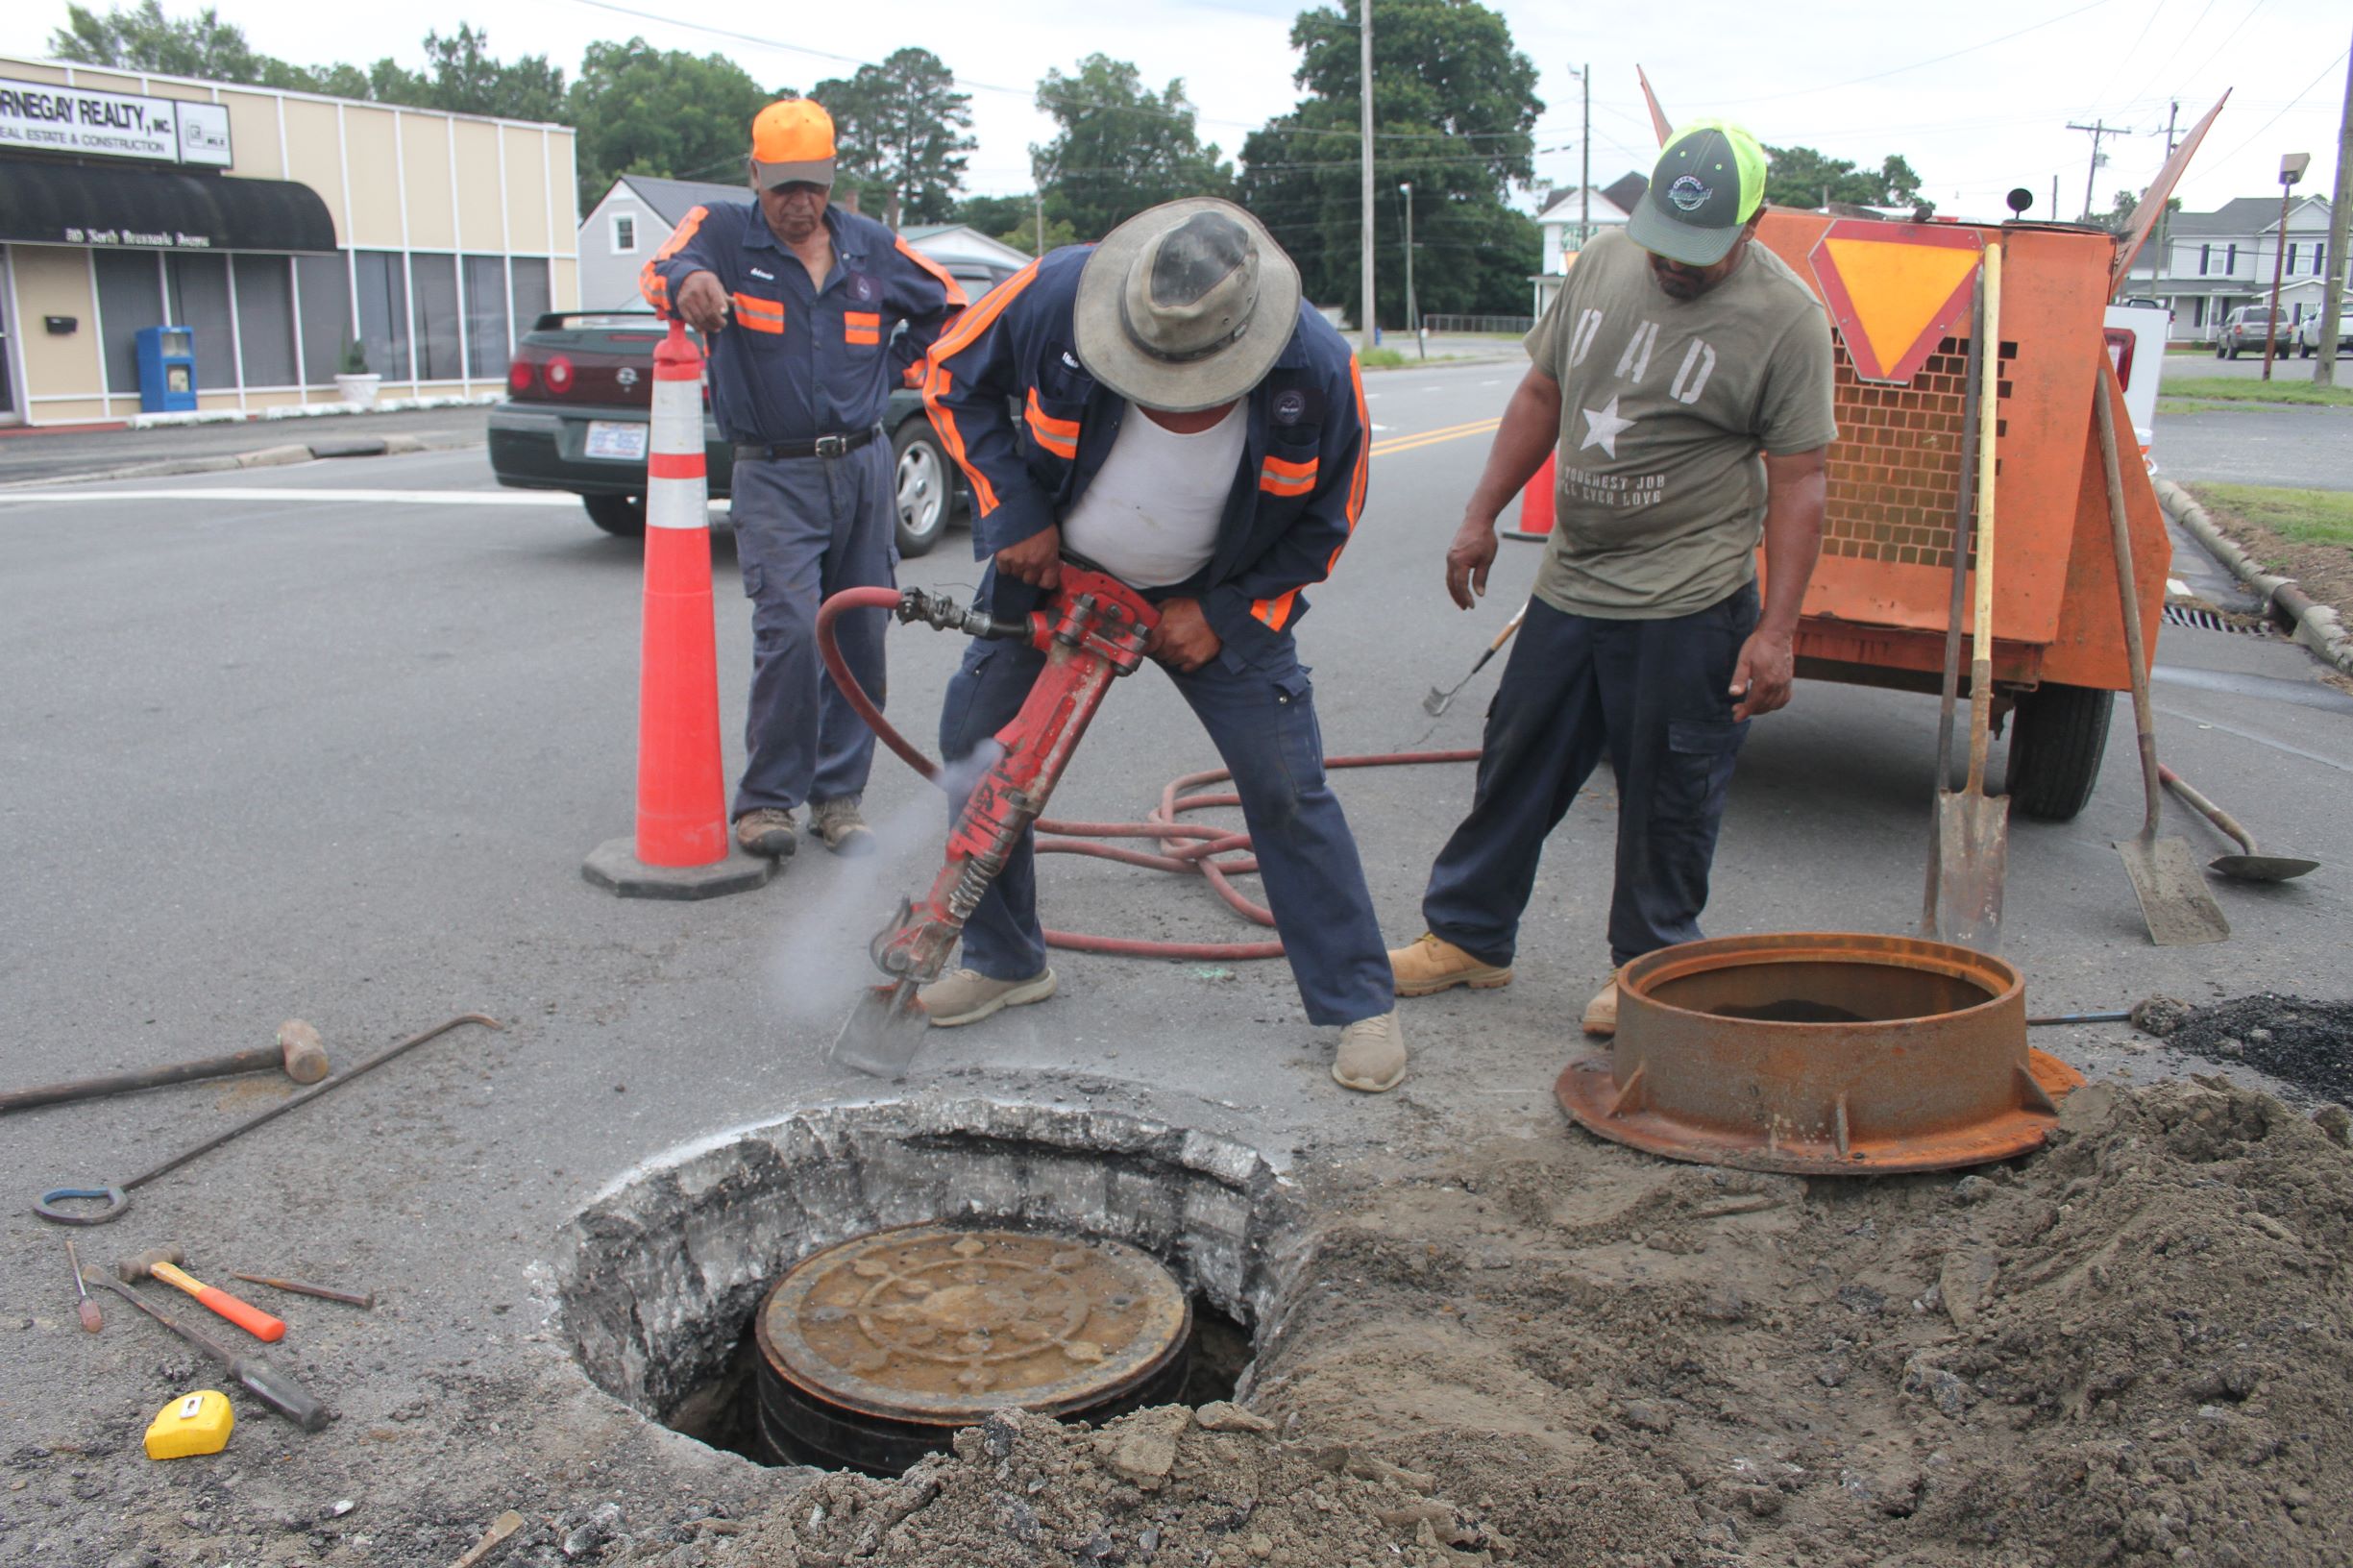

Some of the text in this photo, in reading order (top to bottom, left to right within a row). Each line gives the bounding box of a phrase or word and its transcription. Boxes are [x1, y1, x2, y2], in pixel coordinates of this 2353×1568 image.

[0, 89, 74, 124] RNEGAY
[78, 98, 151, 135] REALTY,
[26, 129, 67, 144] ESTATE
[70, 134, 79, 145] &
[82, 134, 165, 153] CONSTRUCTION
[1570, 307, 1717, 405] DAD
[1564, 466, 1665, 490] TOUGHEST JOB
[1582, 486, 1614, 505] EVER
[1623, 490, 1661, 507] LOVE
